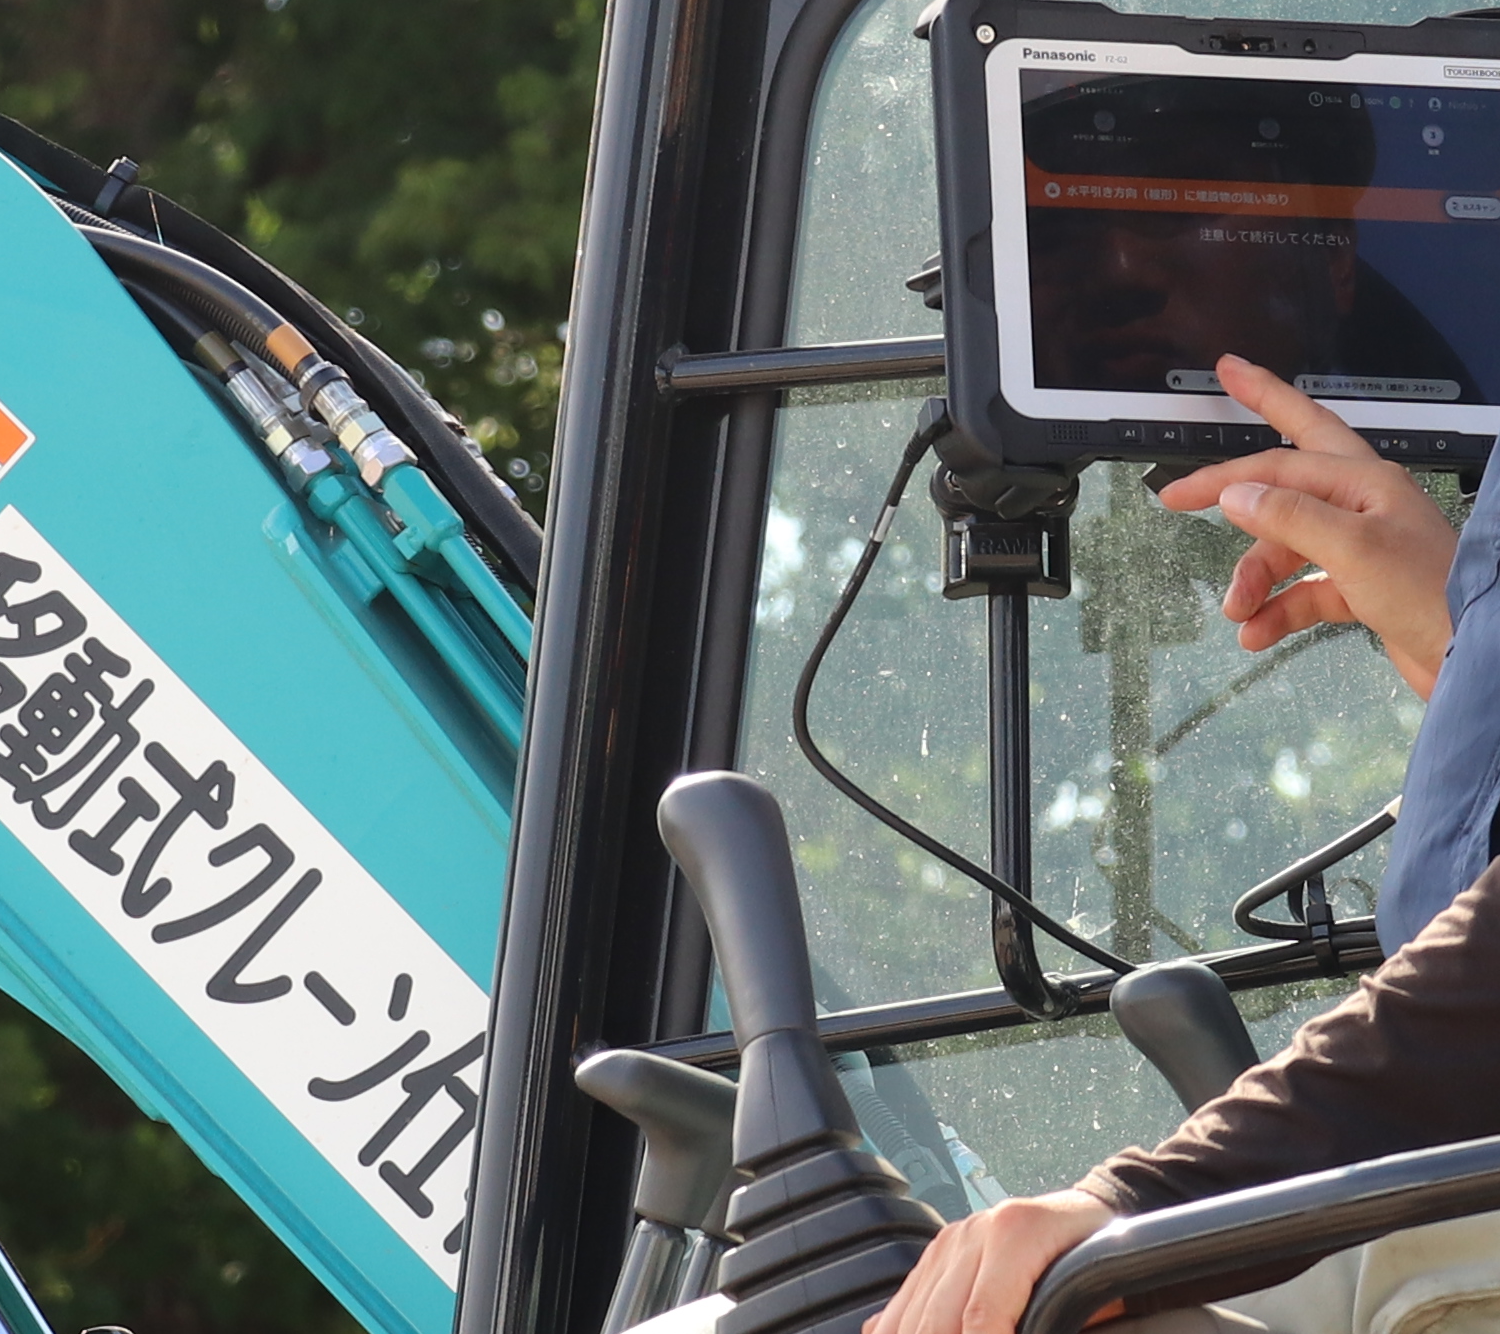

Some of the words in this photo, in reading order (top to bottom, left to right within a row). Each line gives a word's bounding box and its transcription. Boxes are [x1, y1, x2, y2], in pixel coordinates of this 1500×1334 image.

[1022, 48, 1097, 63] Panasonic
[1200, 228, 1350, 247] 注意して続行してください
